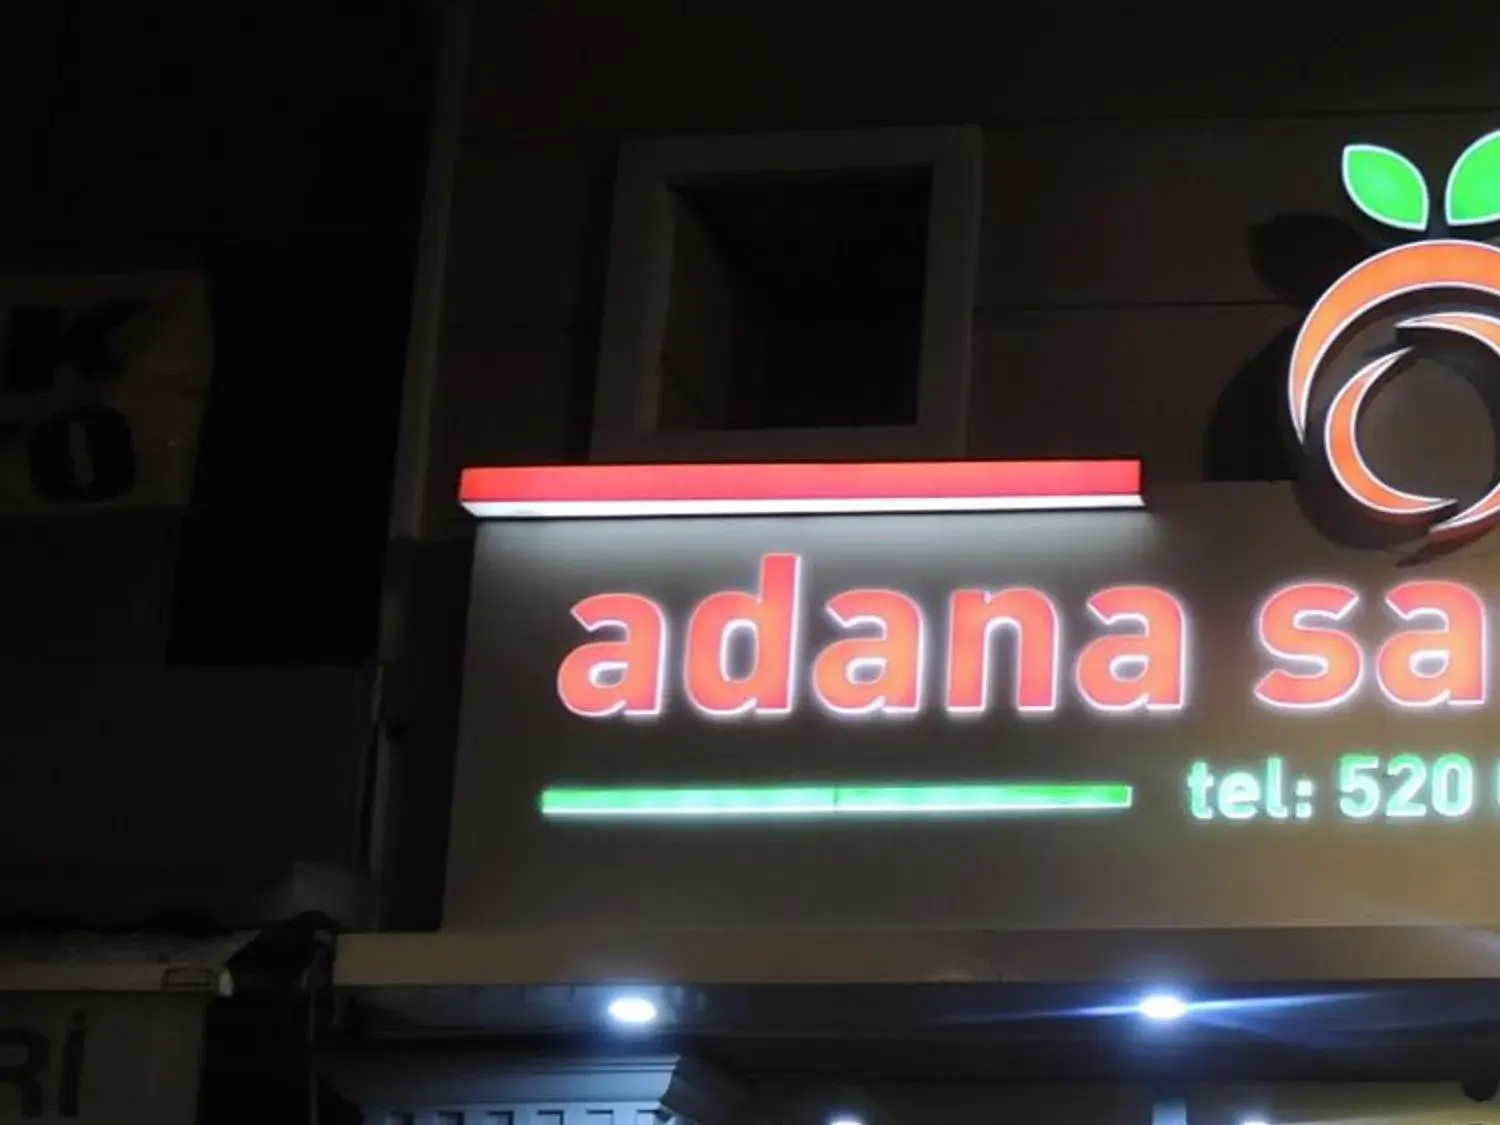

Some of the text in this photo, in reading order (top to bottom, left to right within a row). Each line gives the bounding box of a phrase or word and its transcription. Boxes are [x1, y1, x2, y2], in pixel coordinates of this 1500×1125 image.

[557, 553, 1185, 716] adana
[1187, 757, 1313, 819] tel:
[1339, 752, 1474, 817] 520
